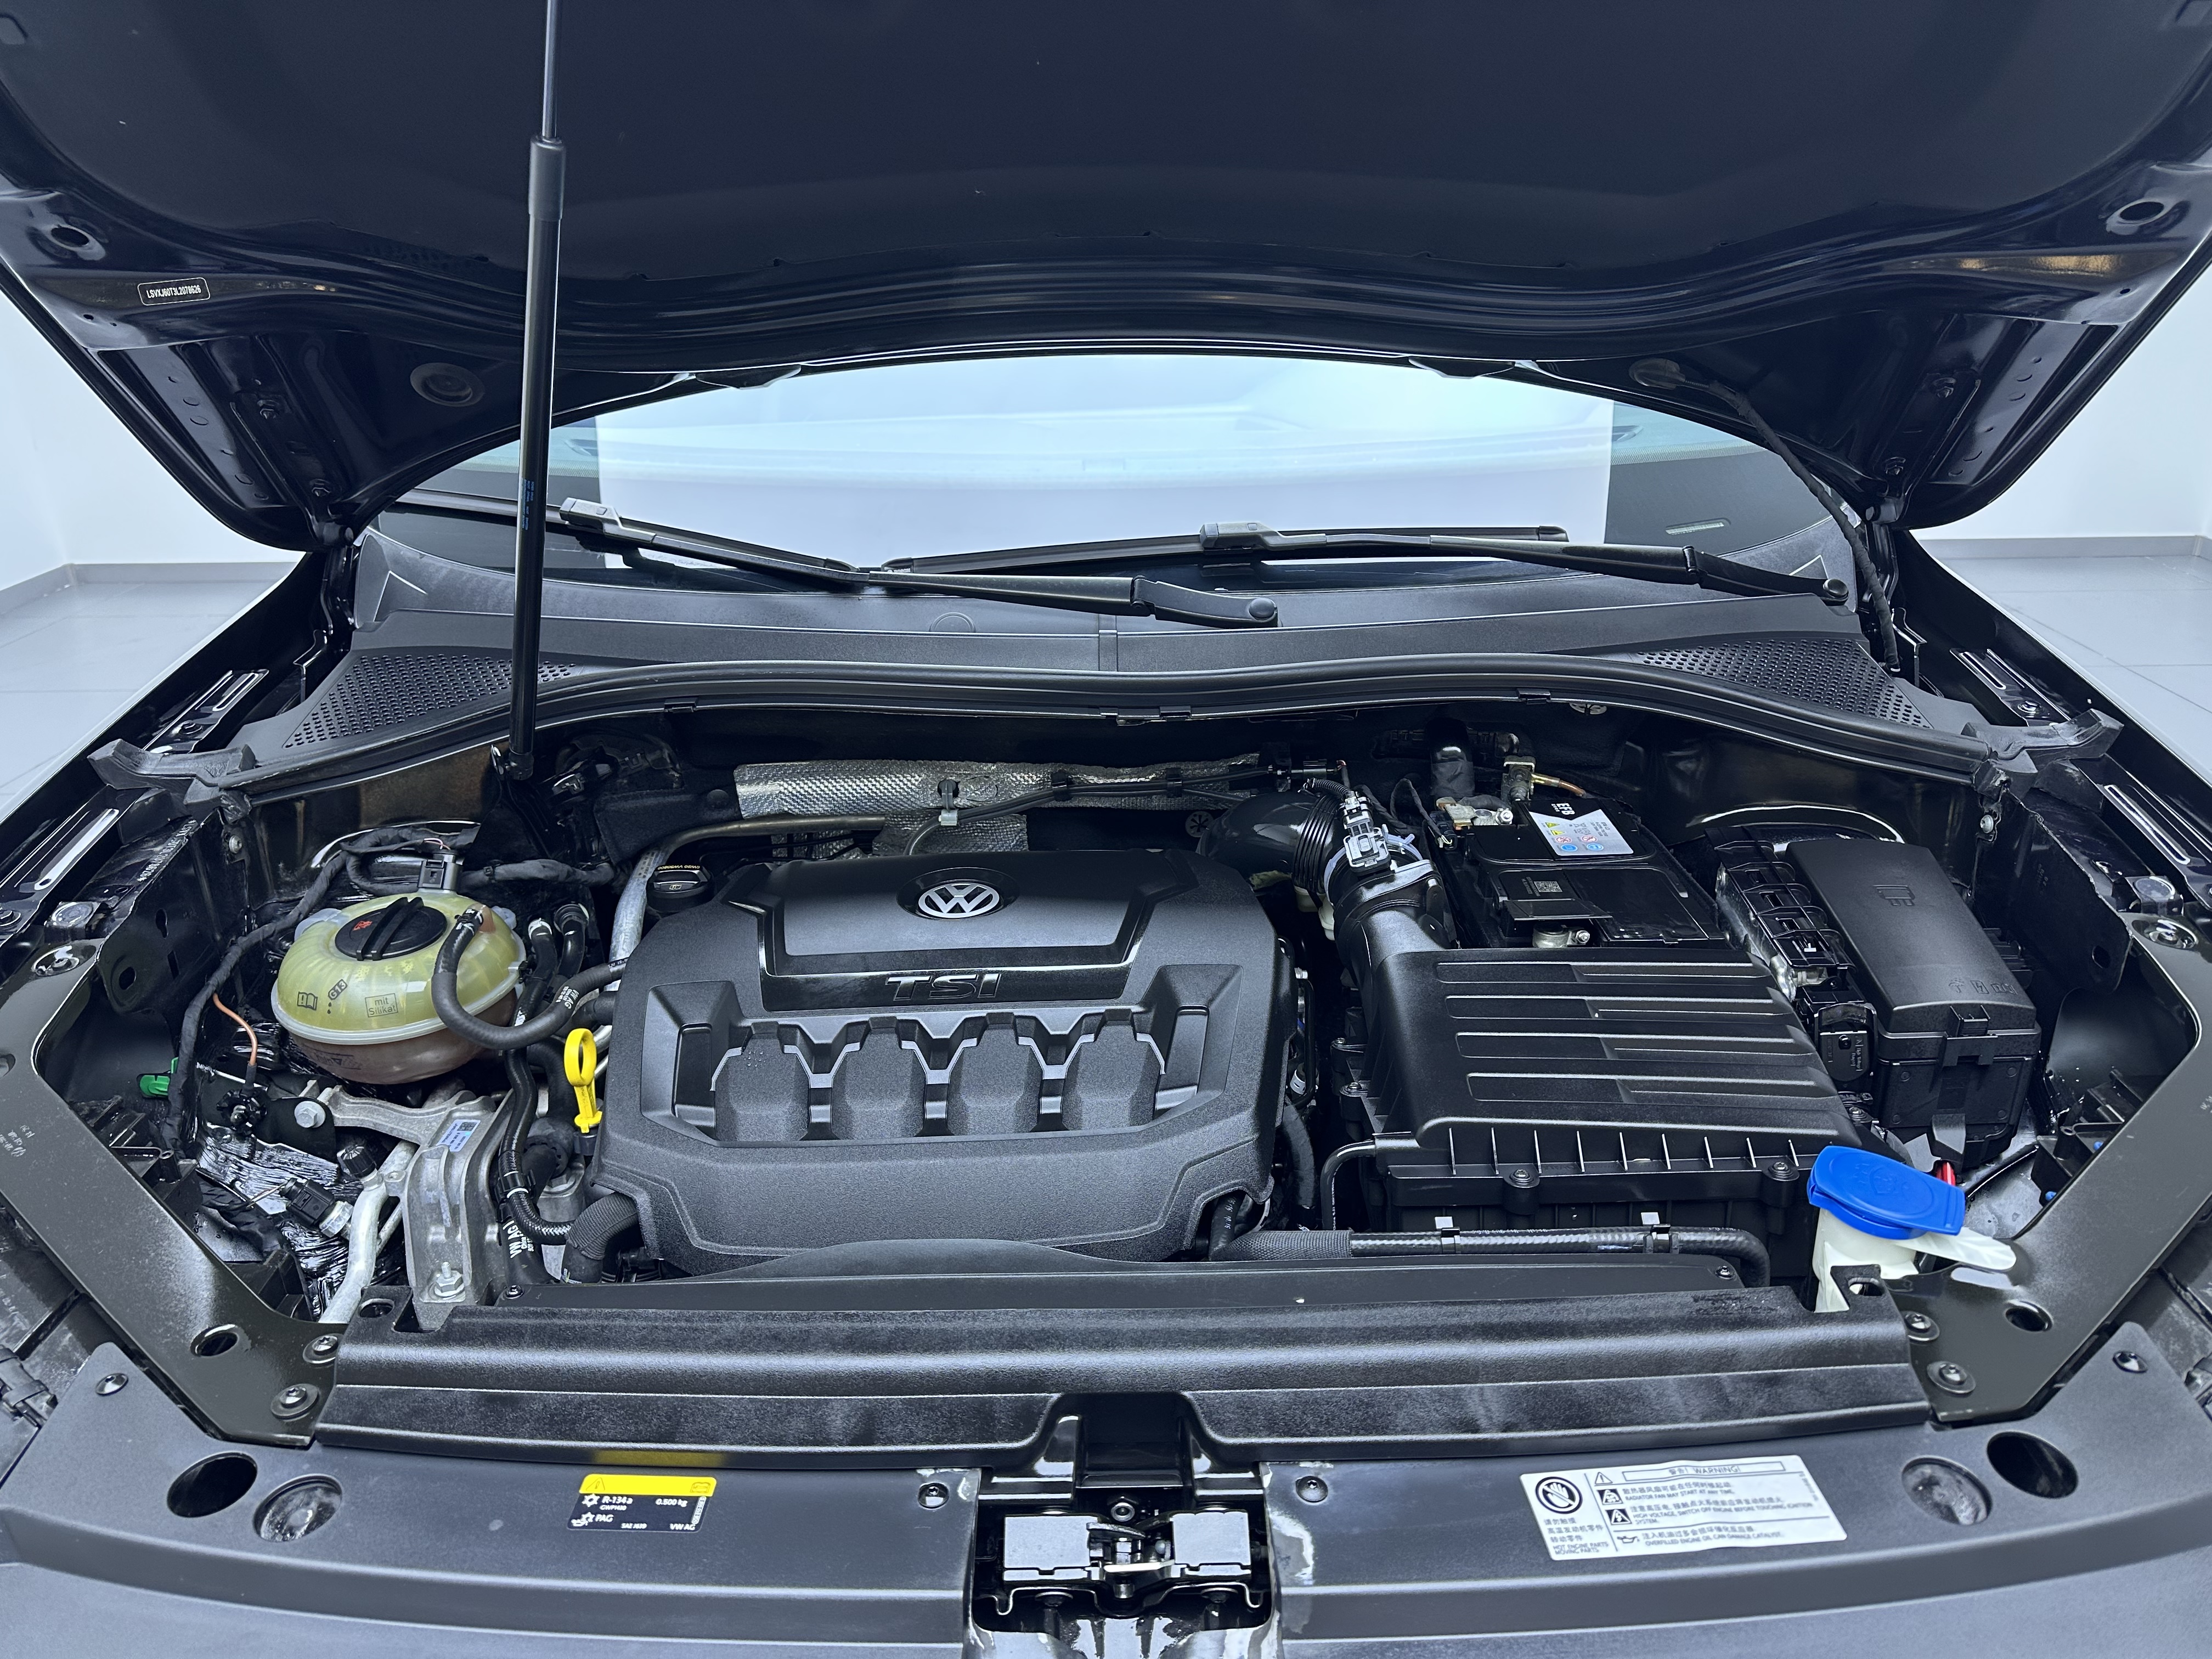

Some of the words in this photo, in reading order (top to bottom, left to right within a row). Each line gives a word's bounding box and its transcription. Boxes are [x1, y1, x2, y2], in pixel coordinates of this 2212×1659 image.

[1556, 802, 1576, 816] EFB
[329, 980, 347, 999] G13
[885, 973, 1002, 1002] TSI
[374, 996, 389, 1006] mit
[368, 1005, 396, 1015] Silikat
[1692, 1465, 1741, 1475] WARNING!
[678, 1499, 688, 1508] kg
[595, 1514, 614, 1523] PAG
